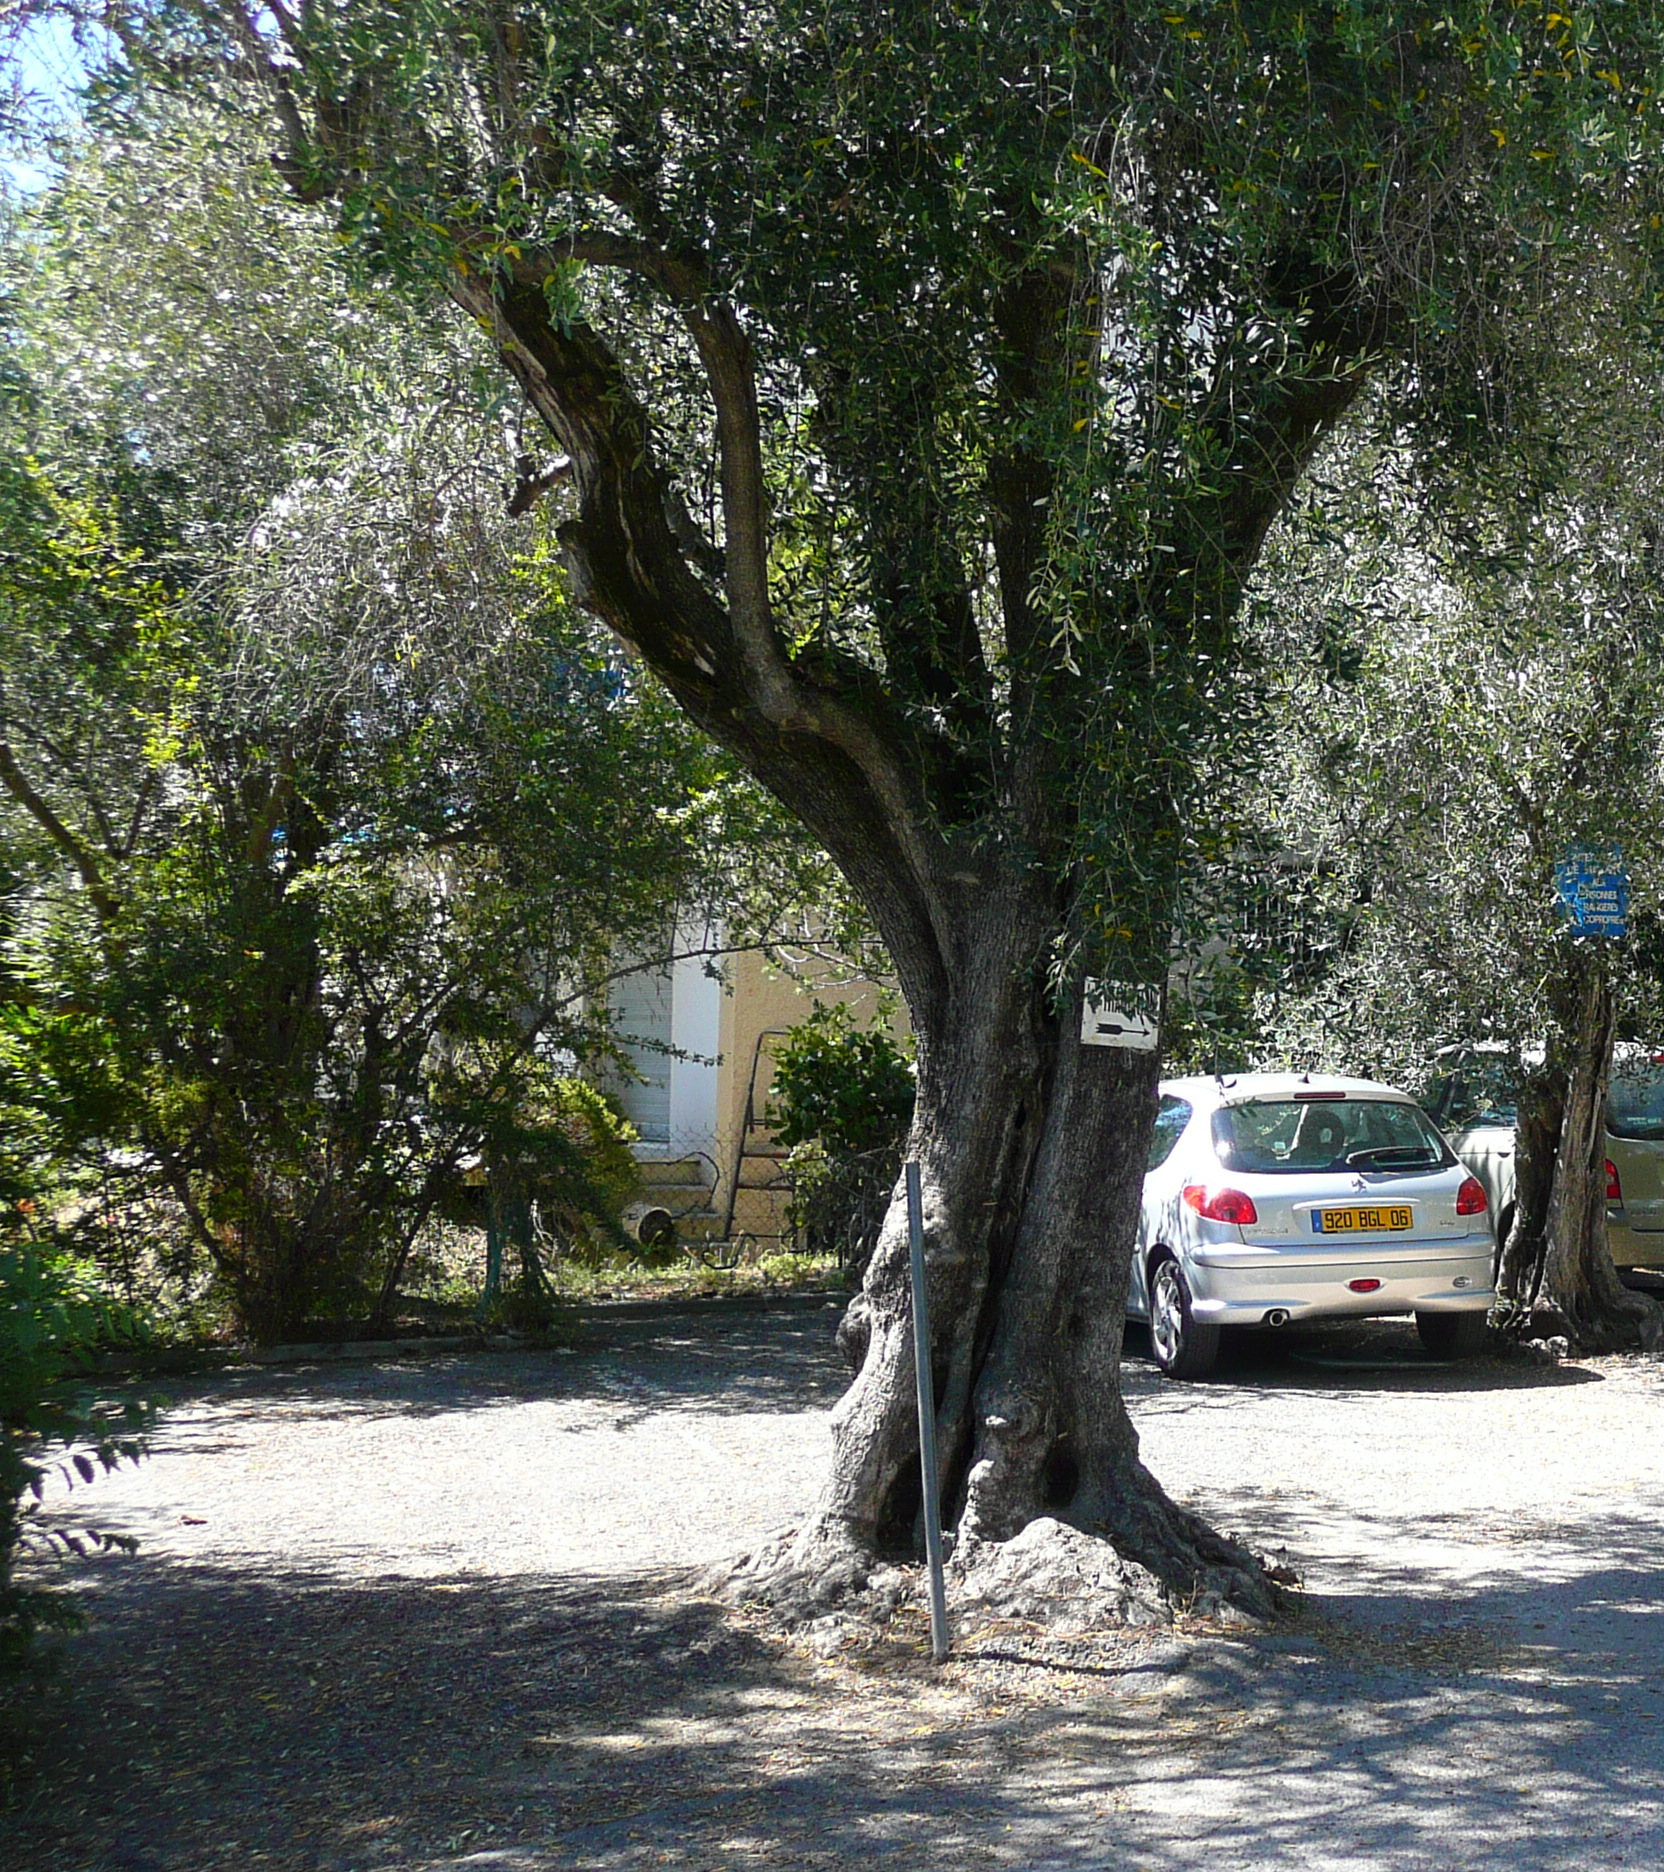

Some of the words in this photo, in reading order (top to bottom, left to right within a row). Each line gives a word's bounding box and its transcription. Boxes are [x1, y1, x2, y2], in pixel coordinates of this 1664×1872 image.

[1324, 1212, 1353, 1229] 920
[1358, 1210, 1386, 1227] BGL
[1390, 1209, 1409, 1226] 06
